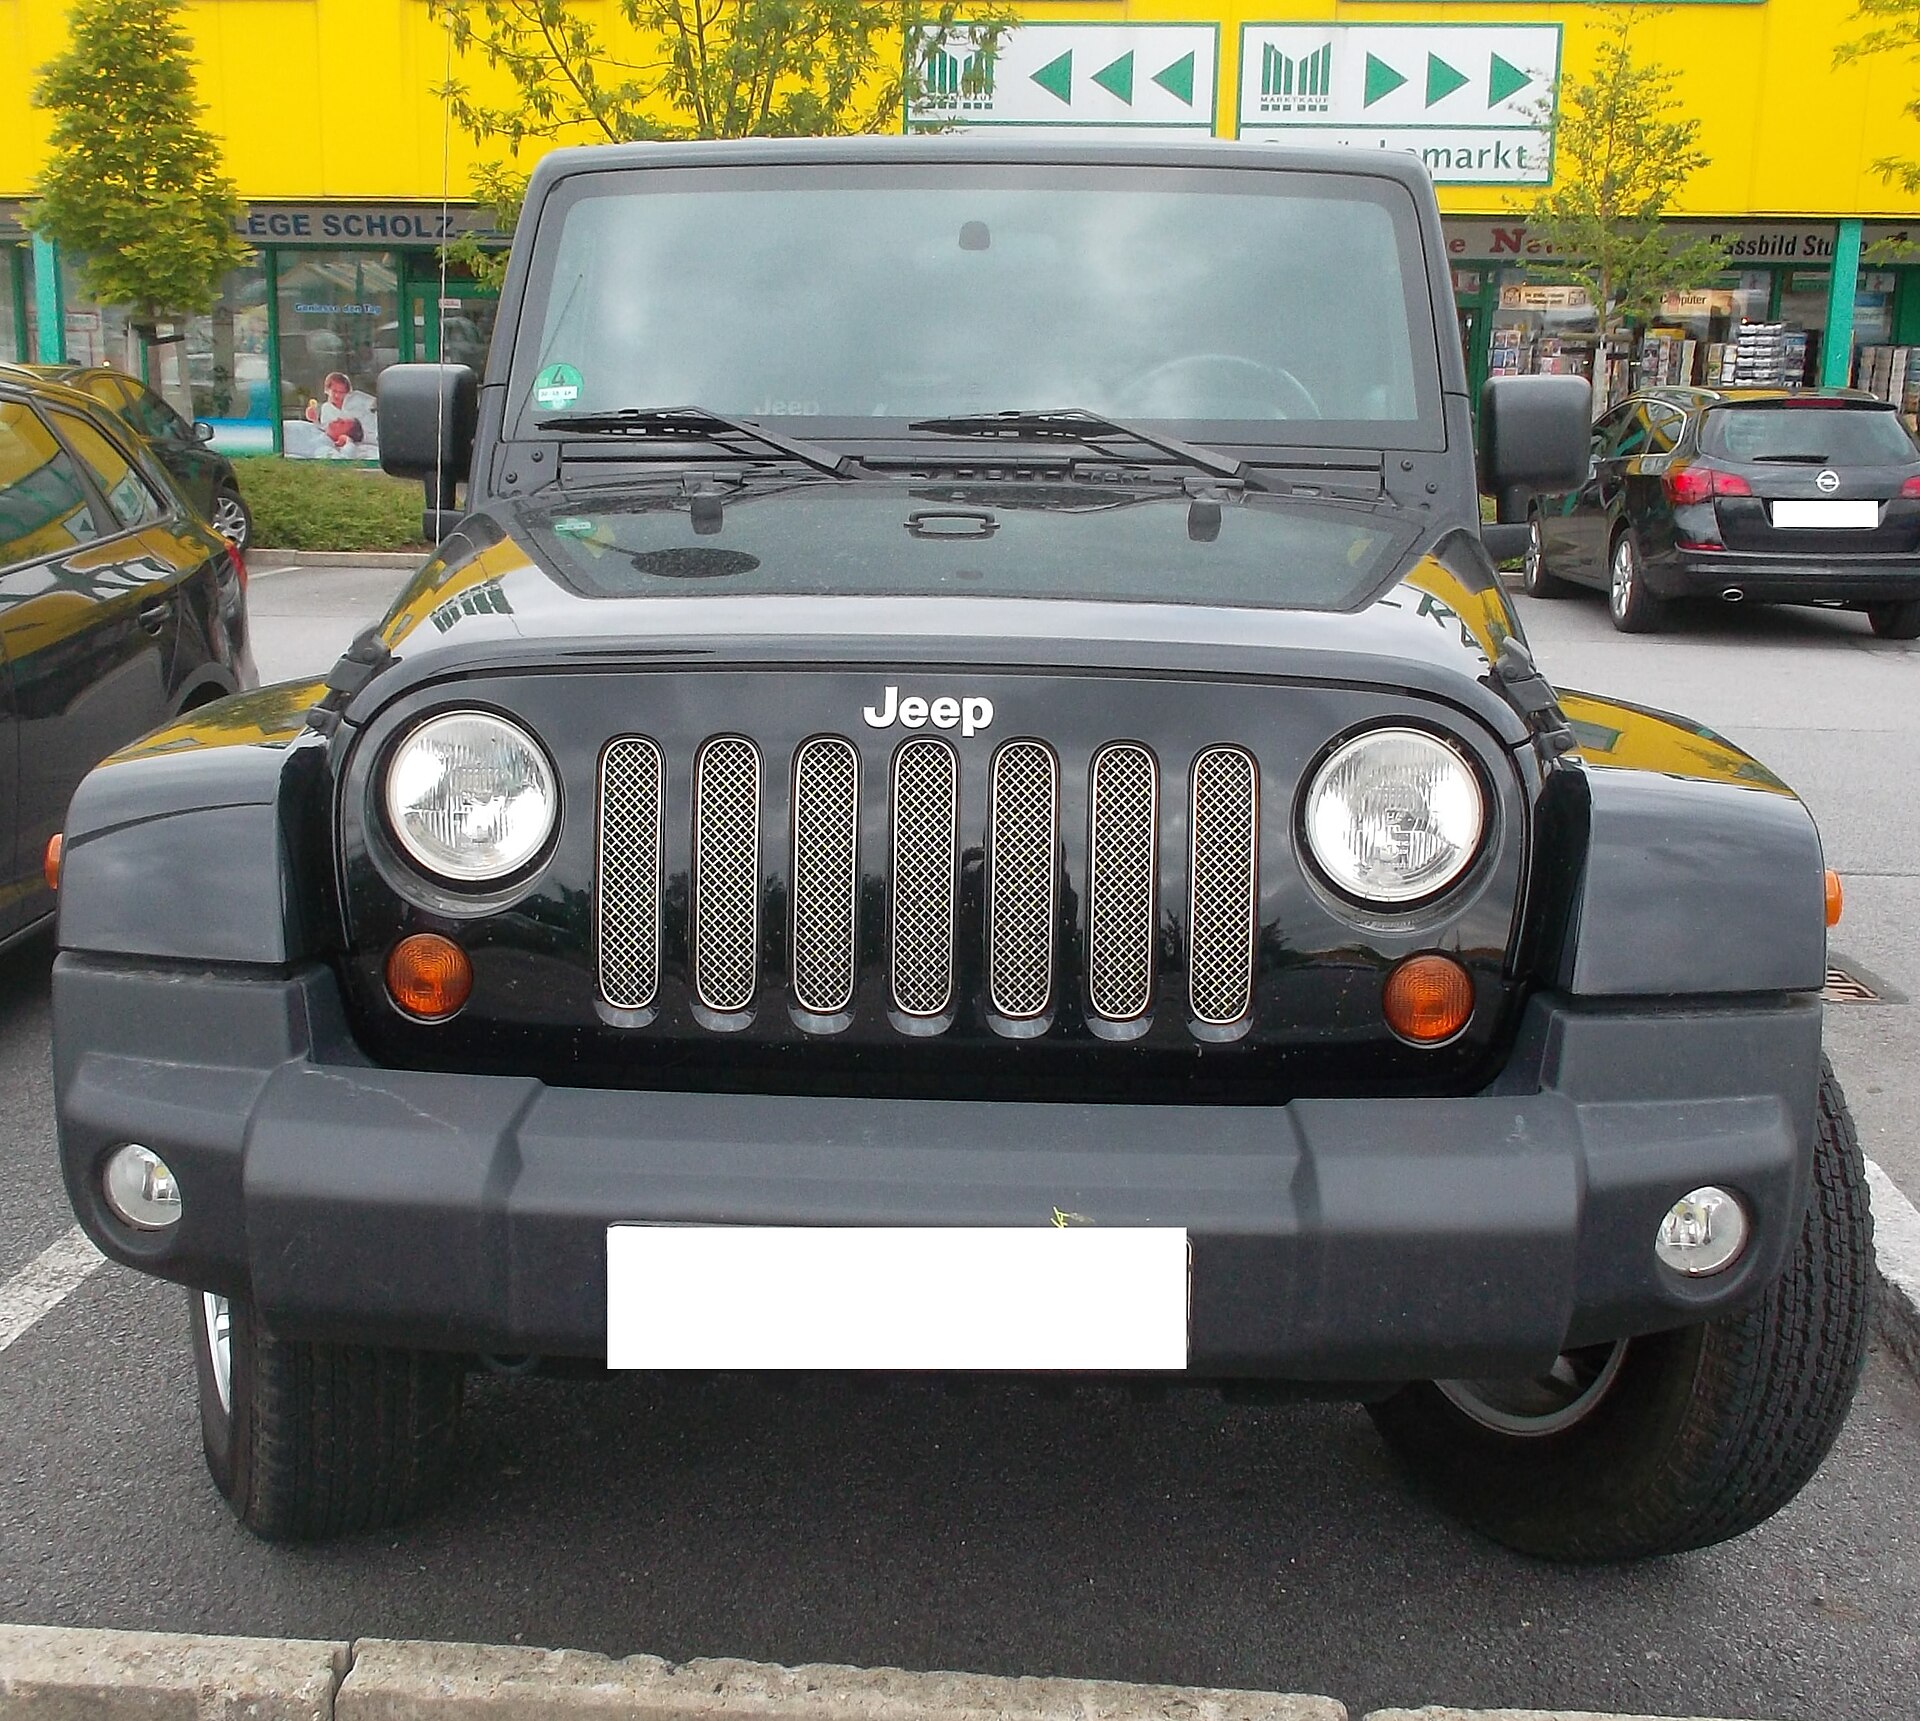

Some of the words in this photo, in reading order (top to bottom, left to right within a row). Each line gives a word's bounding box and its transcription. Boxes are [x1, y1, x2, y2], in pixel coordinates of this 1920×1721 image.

[231, 213, 312, 236] LEGE
[322, 214, 455, 238] SCHOLZ
[1660, 294, 1707, 307] Cputer
[551, 365, 566, 386] 4
[863, 686, 994, 737] Jeep
